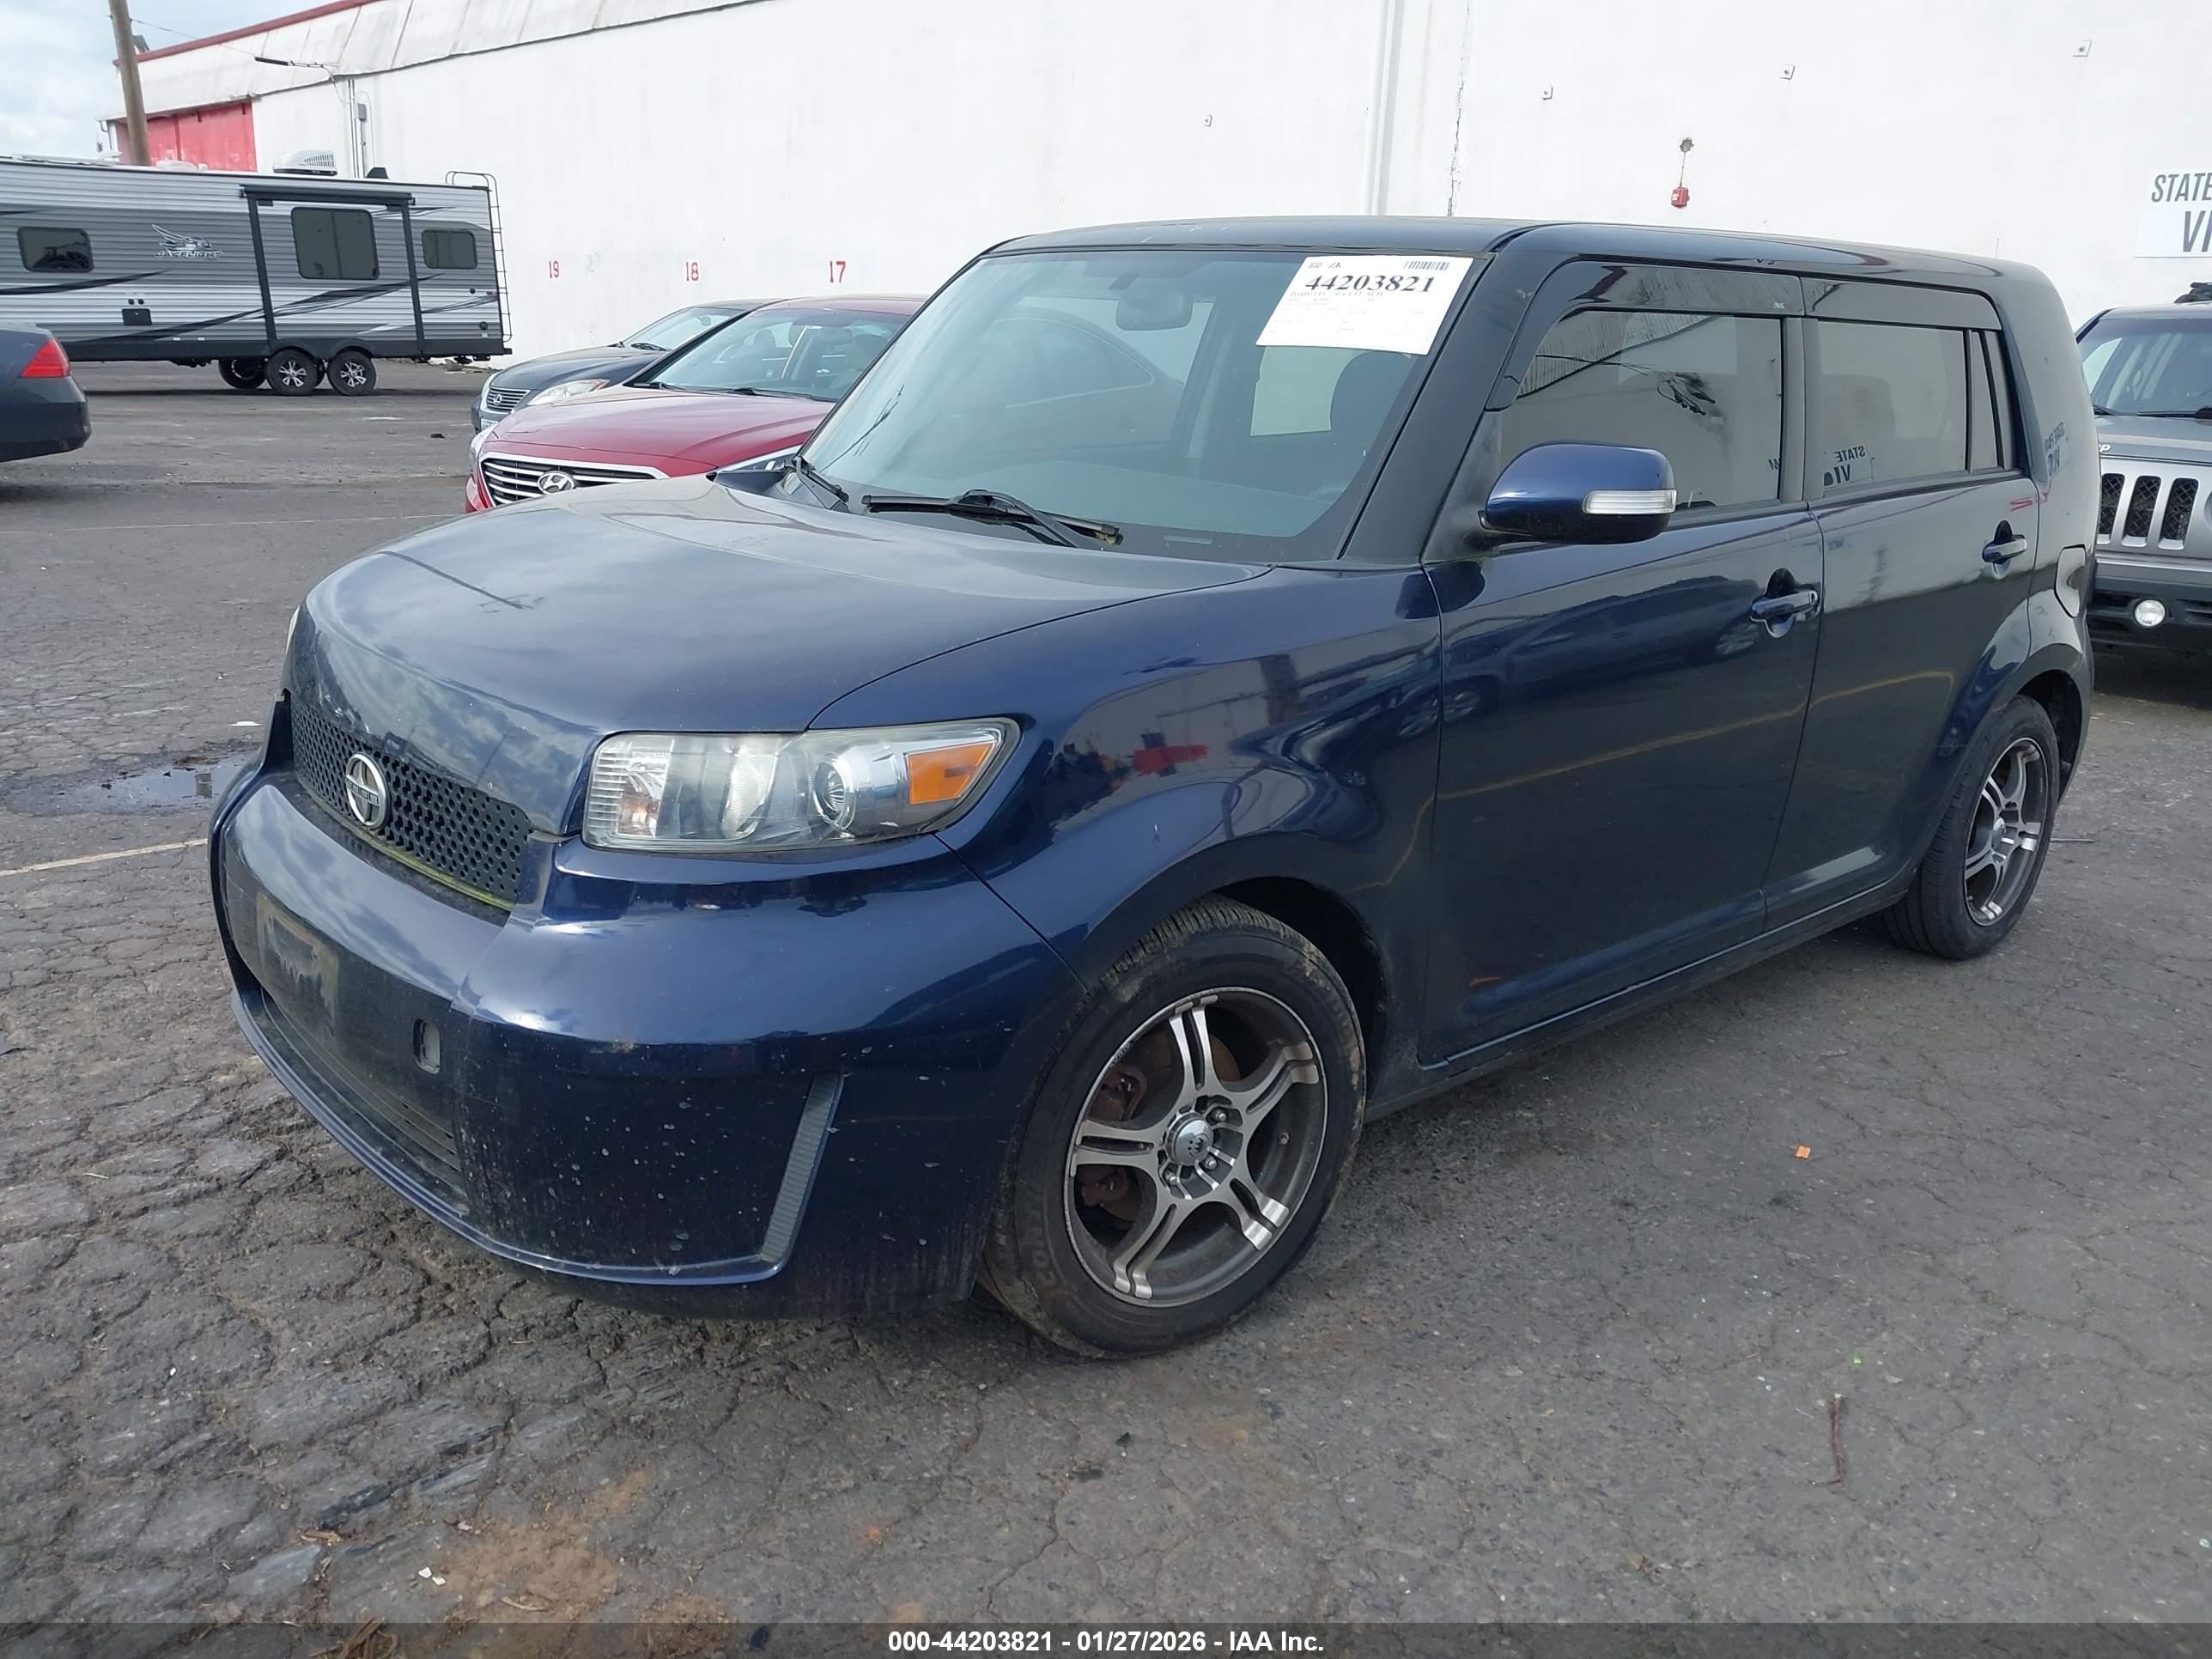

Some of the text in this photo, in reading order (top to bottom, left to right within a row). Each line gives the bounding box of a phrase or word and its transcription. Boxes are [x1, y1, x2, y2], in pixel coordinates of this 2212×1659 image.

[2151, 172, 2212, 203] STATE
[548, 260, 560, 278] 19
[684, 261, 700, 282] 18
[829, 260, 846, 284] 17
[1304, 274, 1435, 293] 44203821
